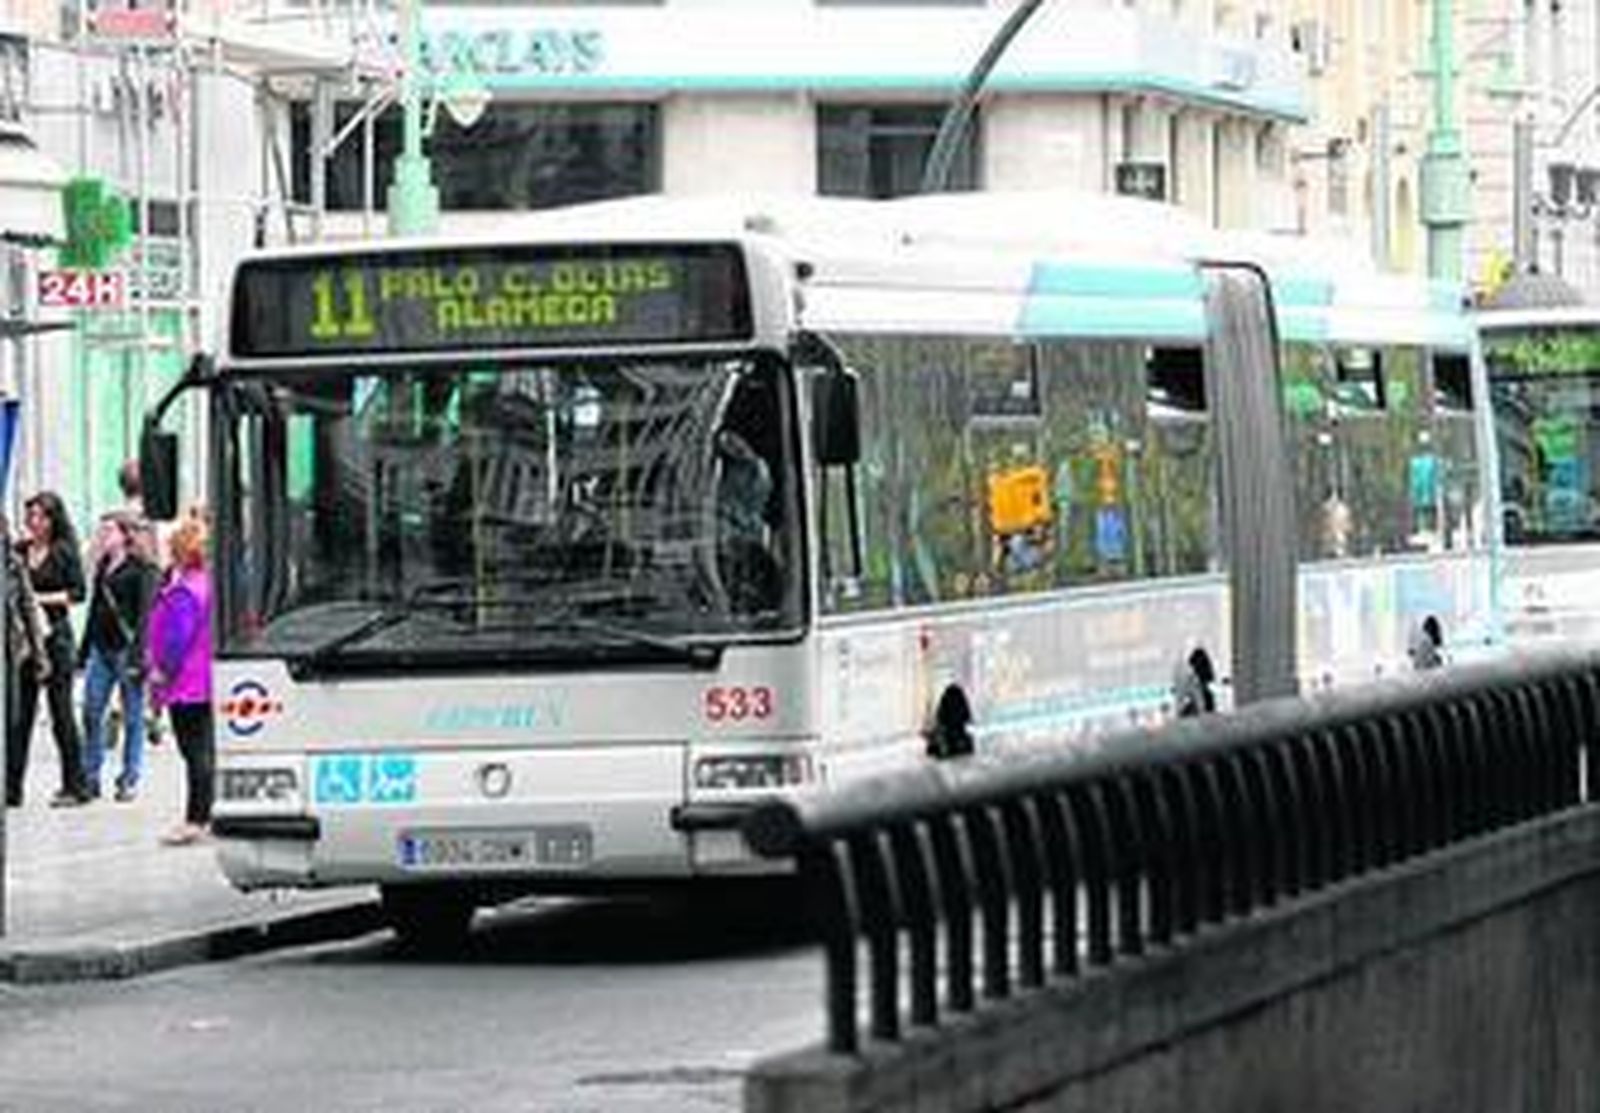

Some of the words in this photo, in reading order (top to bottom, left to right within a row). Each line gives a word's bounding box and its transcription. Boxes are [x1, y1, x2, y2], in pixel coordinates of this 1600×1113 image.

[42, 274, 122, 306] 24H
[310, 269, 374, 338] 11
[381, 266, 480, 299] PALO
[705, 686, 773, 721] 533
